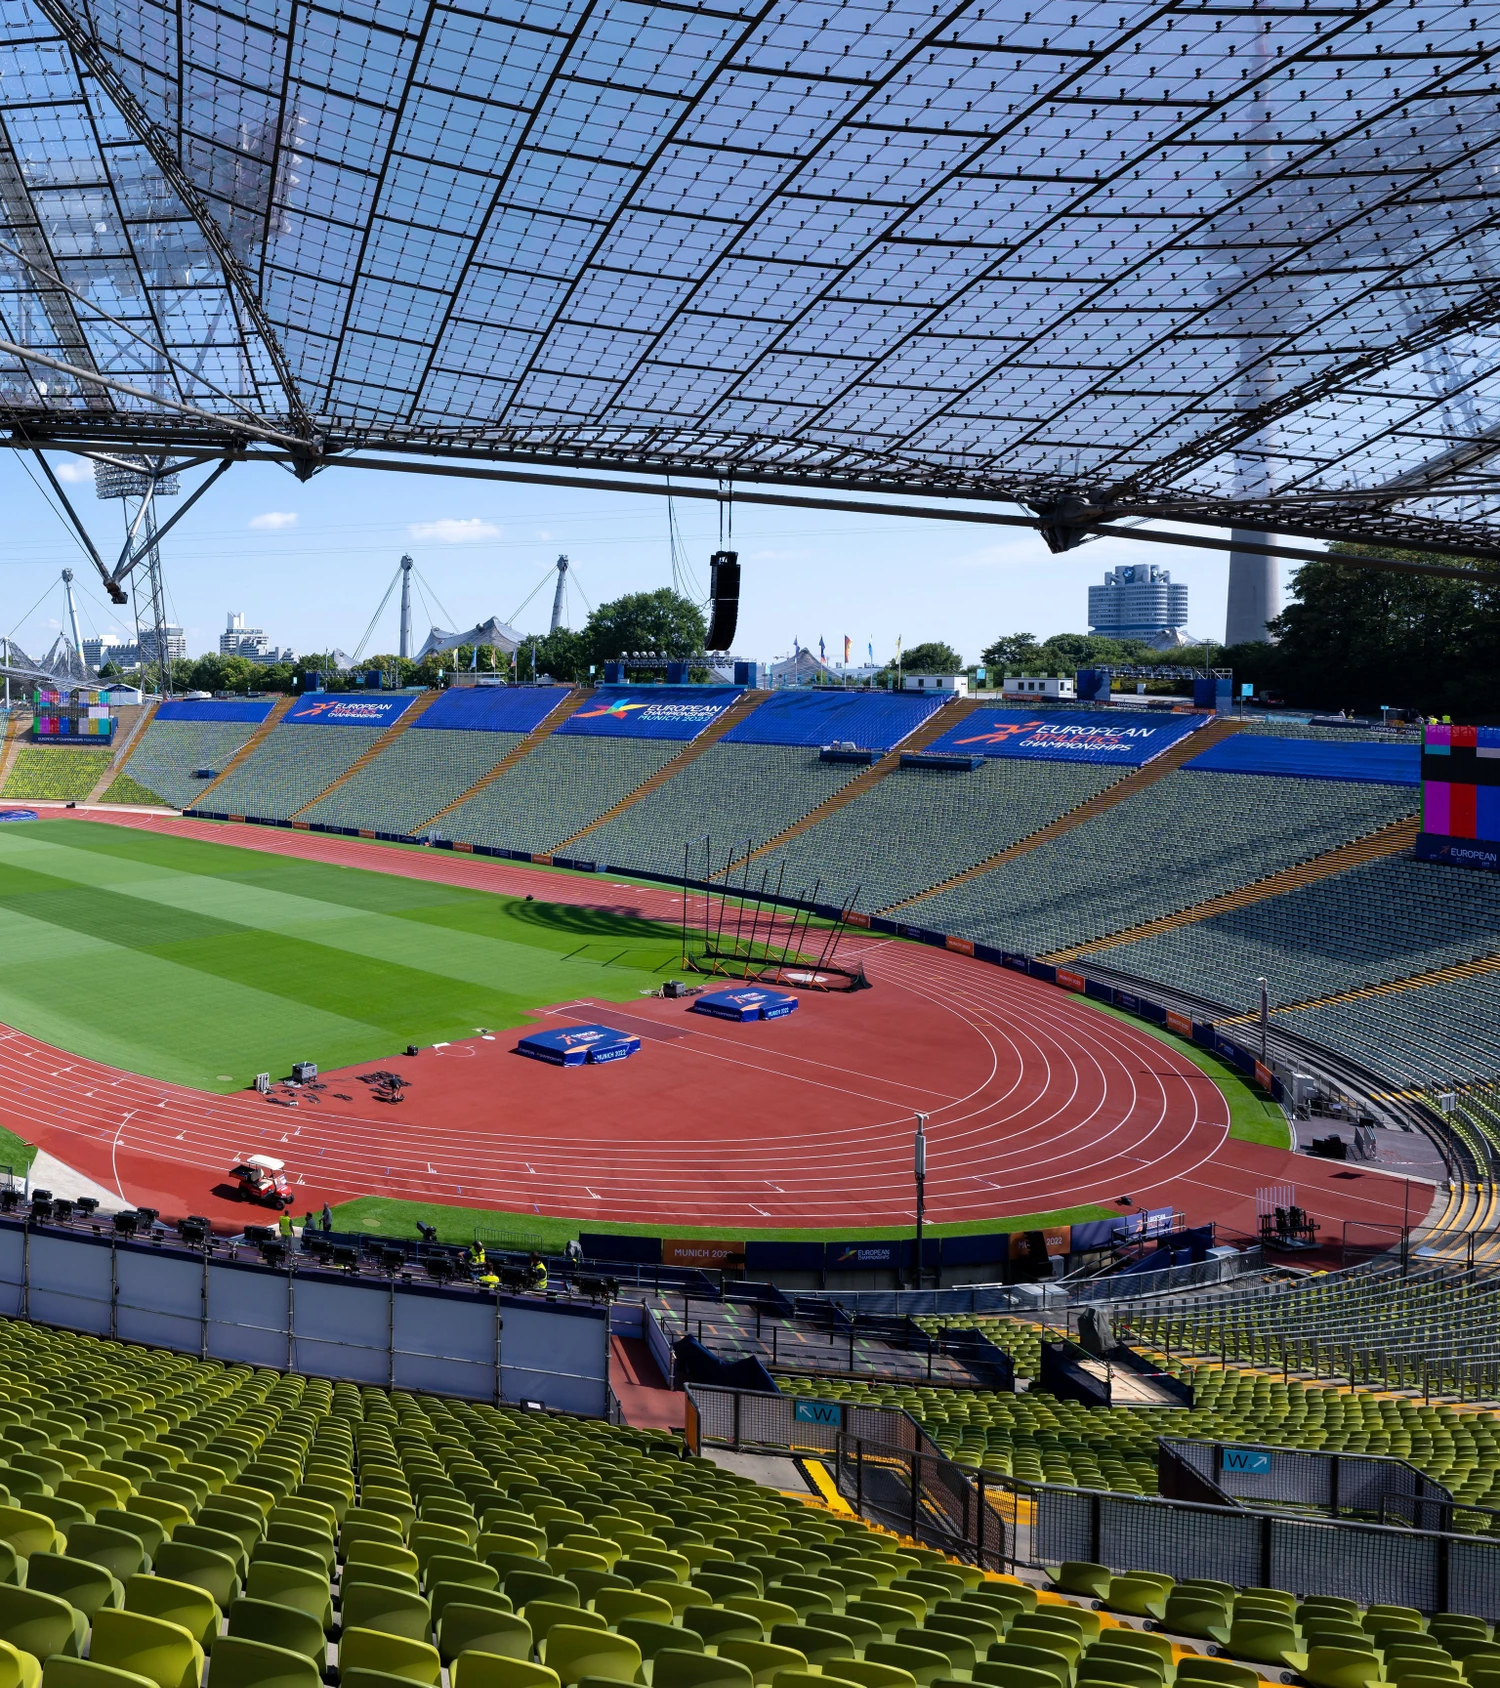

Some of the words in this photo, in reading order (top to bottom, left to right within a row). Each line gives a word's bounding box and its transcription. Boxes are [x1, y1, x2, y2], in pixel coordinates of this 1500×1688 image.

[647, 704, 722, 712] EUROPEAN
[1036, 725, 1157, 738] EUROPEAN
[1026, 734, 1123, 744] ATHLETICS
[1019, 740, 1134, 751] CHAMPIONSHIPS
[1450, 847, 1497, 862] EUROPEAN
[596, 1052, 614, 1061] MUNICH
[615, 1049, 627, 1057] 2022
[1046, 1237, 1063, 1247] 2022
[674, 1248, 709, 1258] MUNICH
